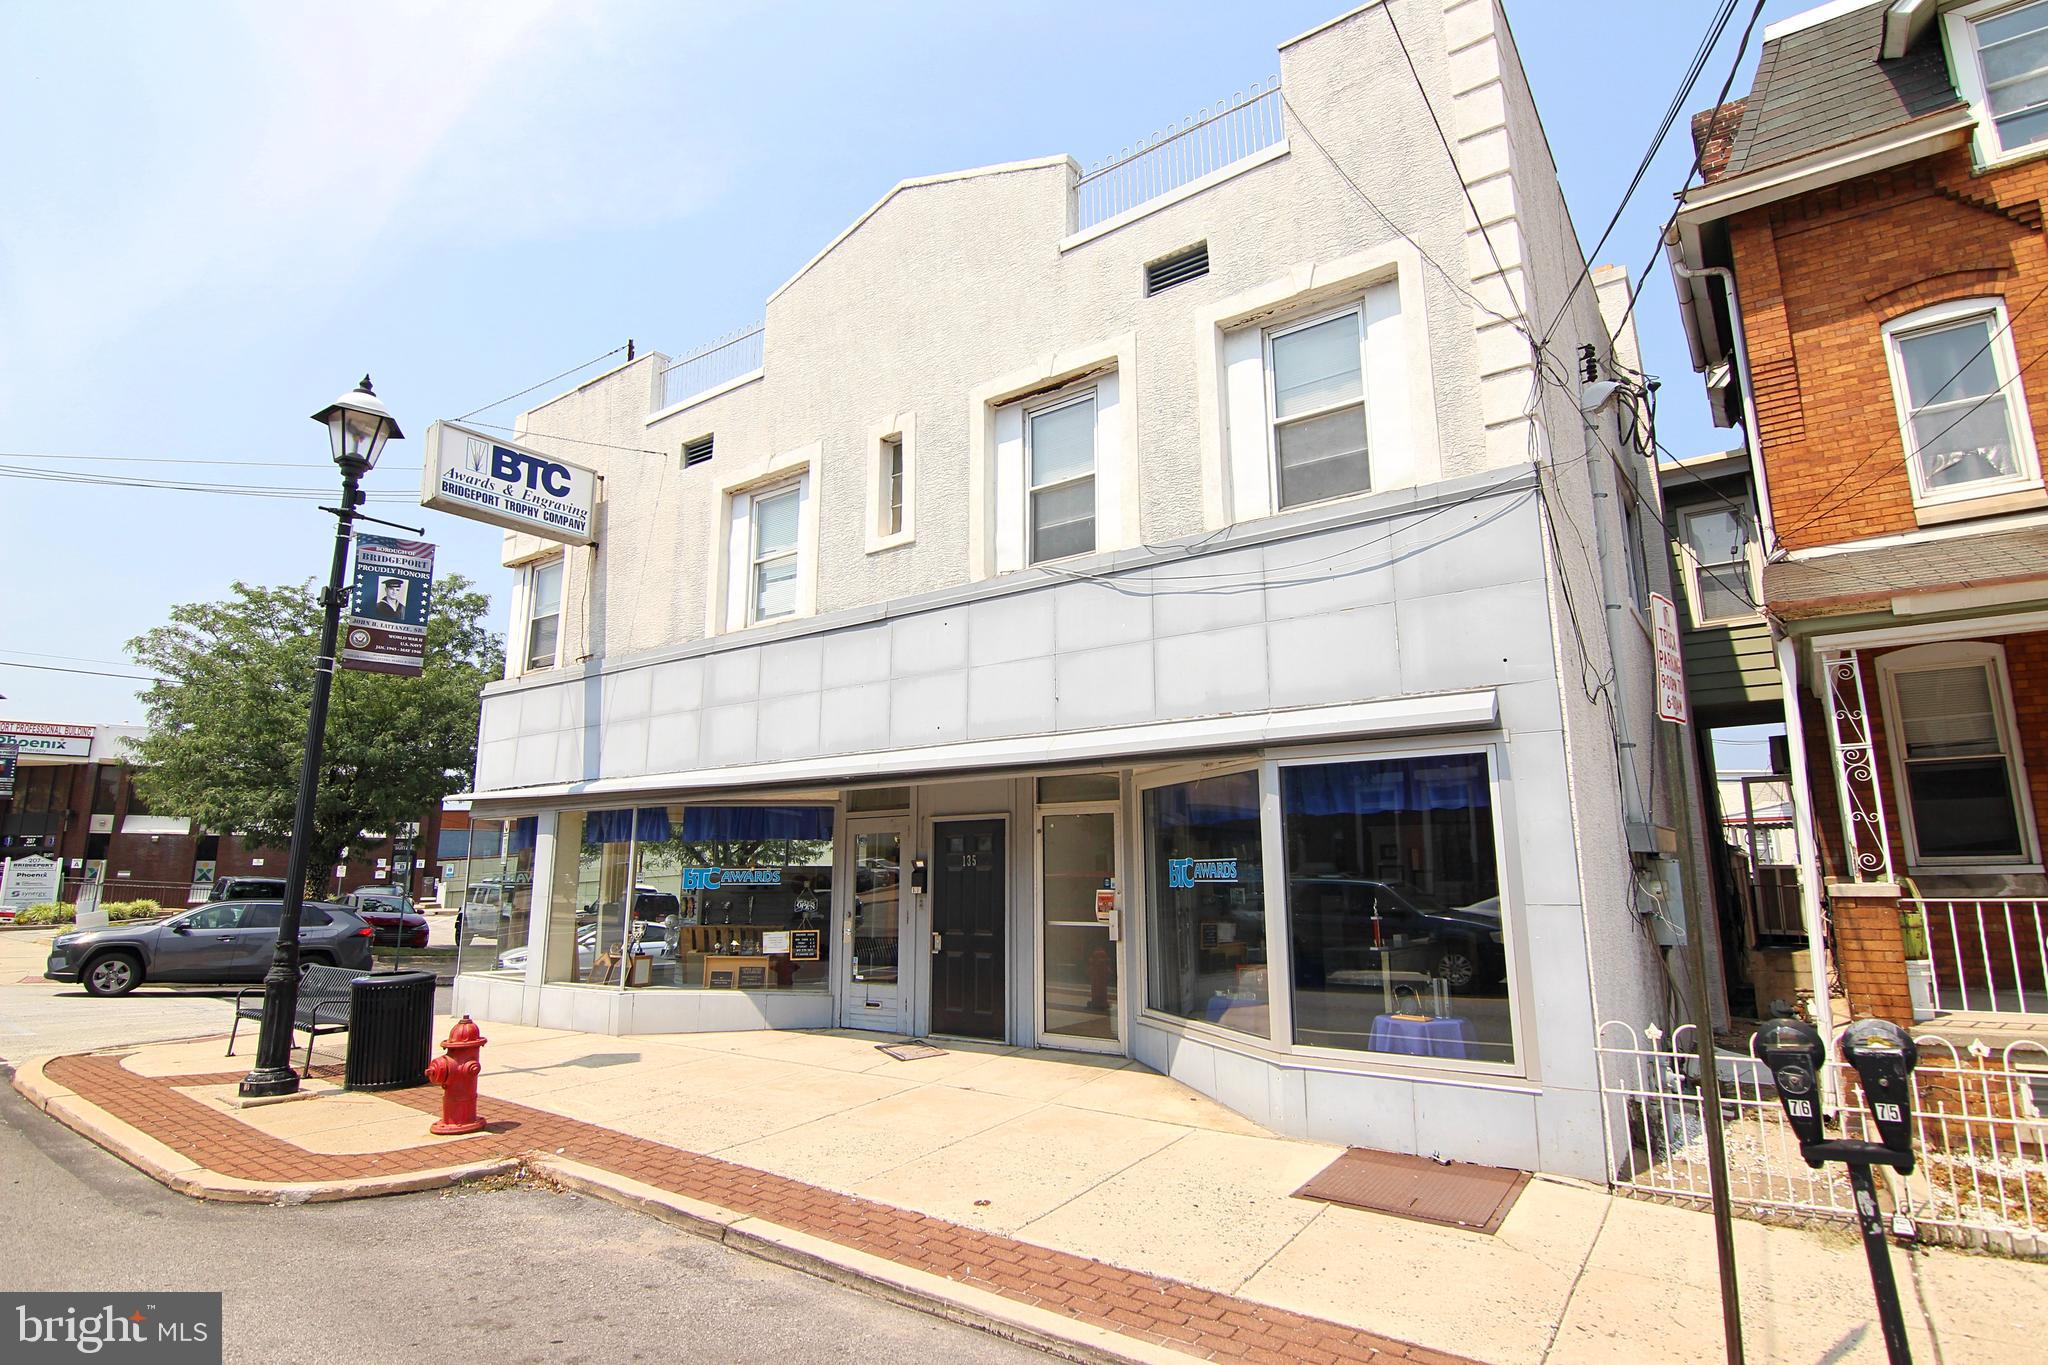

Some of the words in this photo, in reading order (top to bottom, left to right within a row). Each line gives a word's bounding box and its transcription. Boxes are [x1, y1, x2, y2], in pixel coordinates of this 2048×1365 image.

[491, 445, 572, 498] BTC
[443, 467, 496, 491] Awards
[502, 484, 514, 496] &
[522, 488, 588, 520] Engraving
[441, 480, 500, 507] BRIDGEPORT
[504, 499, 540, 518] TROPHY
[542, 510, 586, 532] COMPANY
[362, 552, 428, 568] BRIDGEPORT
[357, 564, 396, 574] PROUDLY
[397, 569, 430, 579] HONORS
[16, 724, 62, 734] PROFESSIONAL
[64, 726, 92, 736] BUILDING
[962, 855, 977, 867] 135
[682, 866, 721, 890] BTC
[720, 870, 781, 883] AWARDS
[1168, 857, 1194, 888] BTC
[1194, 862, 1238, 878] AWARDS
[1790, 1100, 1810, 1116] 76
[1876, 1104, 1899, 1120] 75
